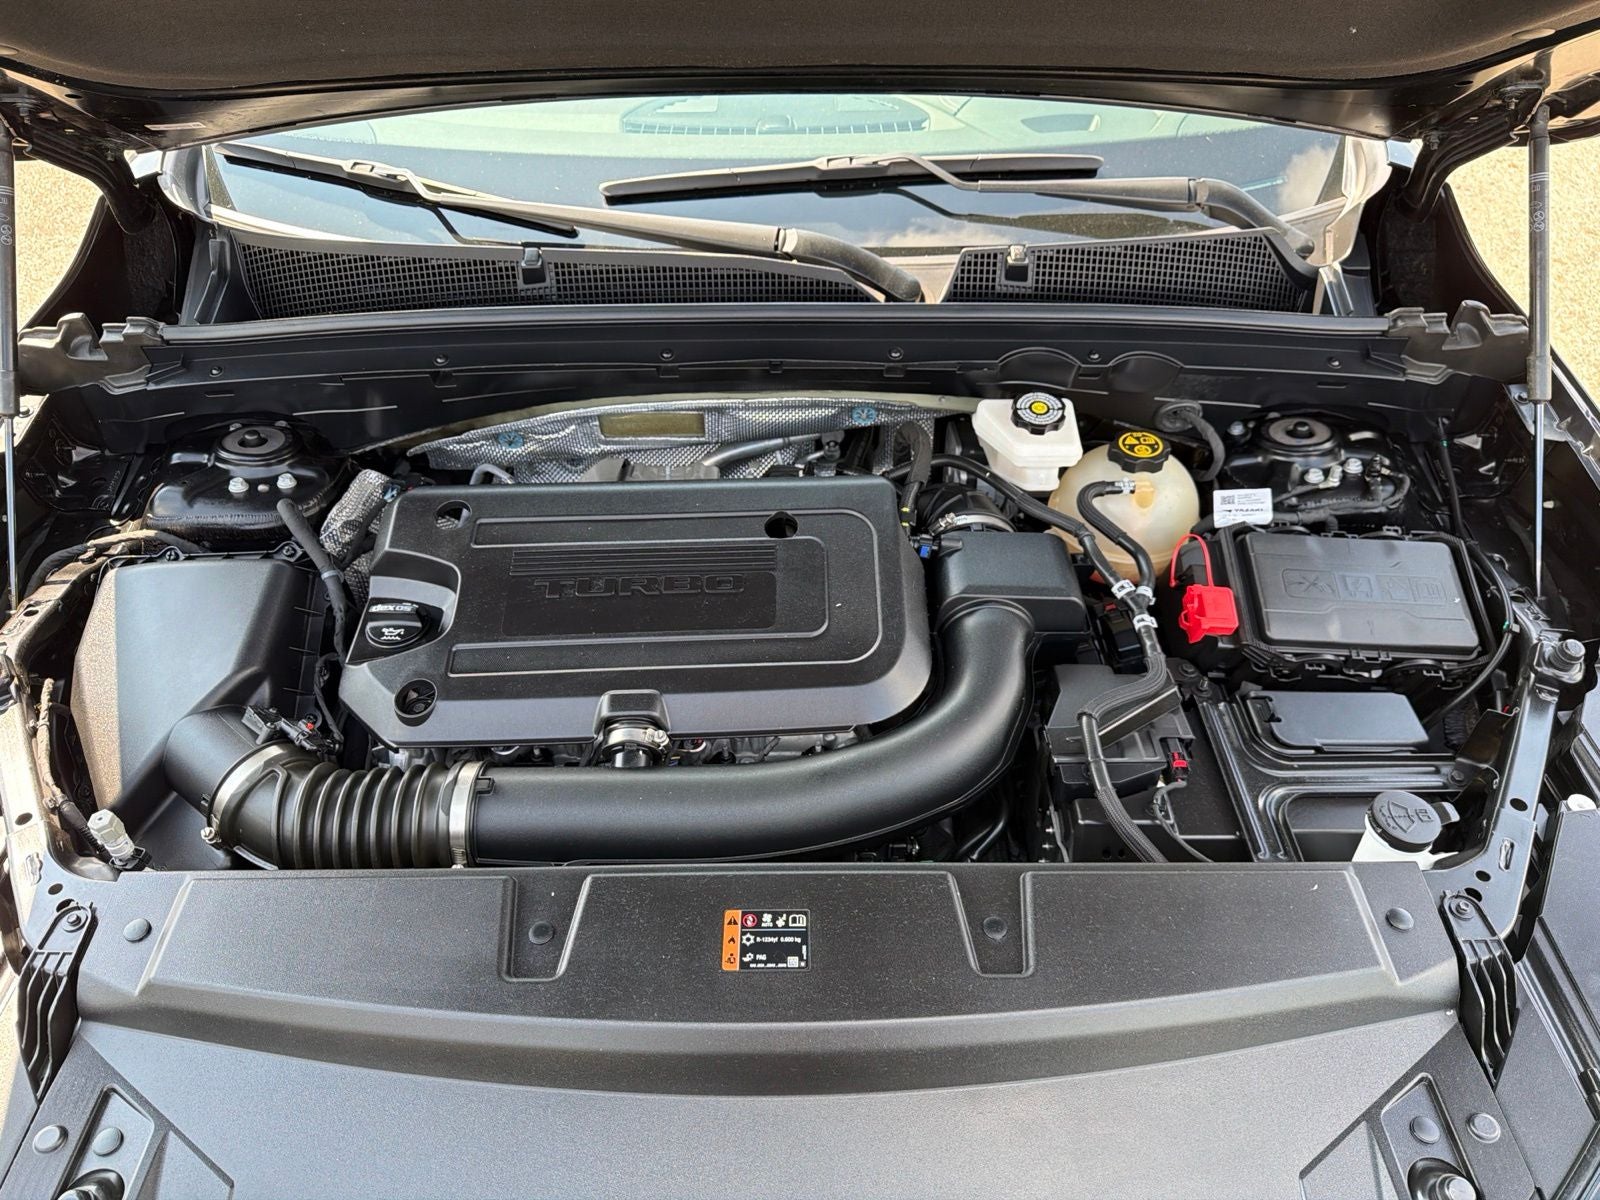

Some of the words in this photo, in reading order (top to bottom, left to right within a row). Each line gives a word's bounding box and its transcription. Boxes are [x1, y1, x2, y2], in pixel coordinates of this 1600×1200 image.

[533, 573, 745, 599] TURBO
[756, 936, 778, 944] R-1234yf
[795, 936, 801, 944] kg
